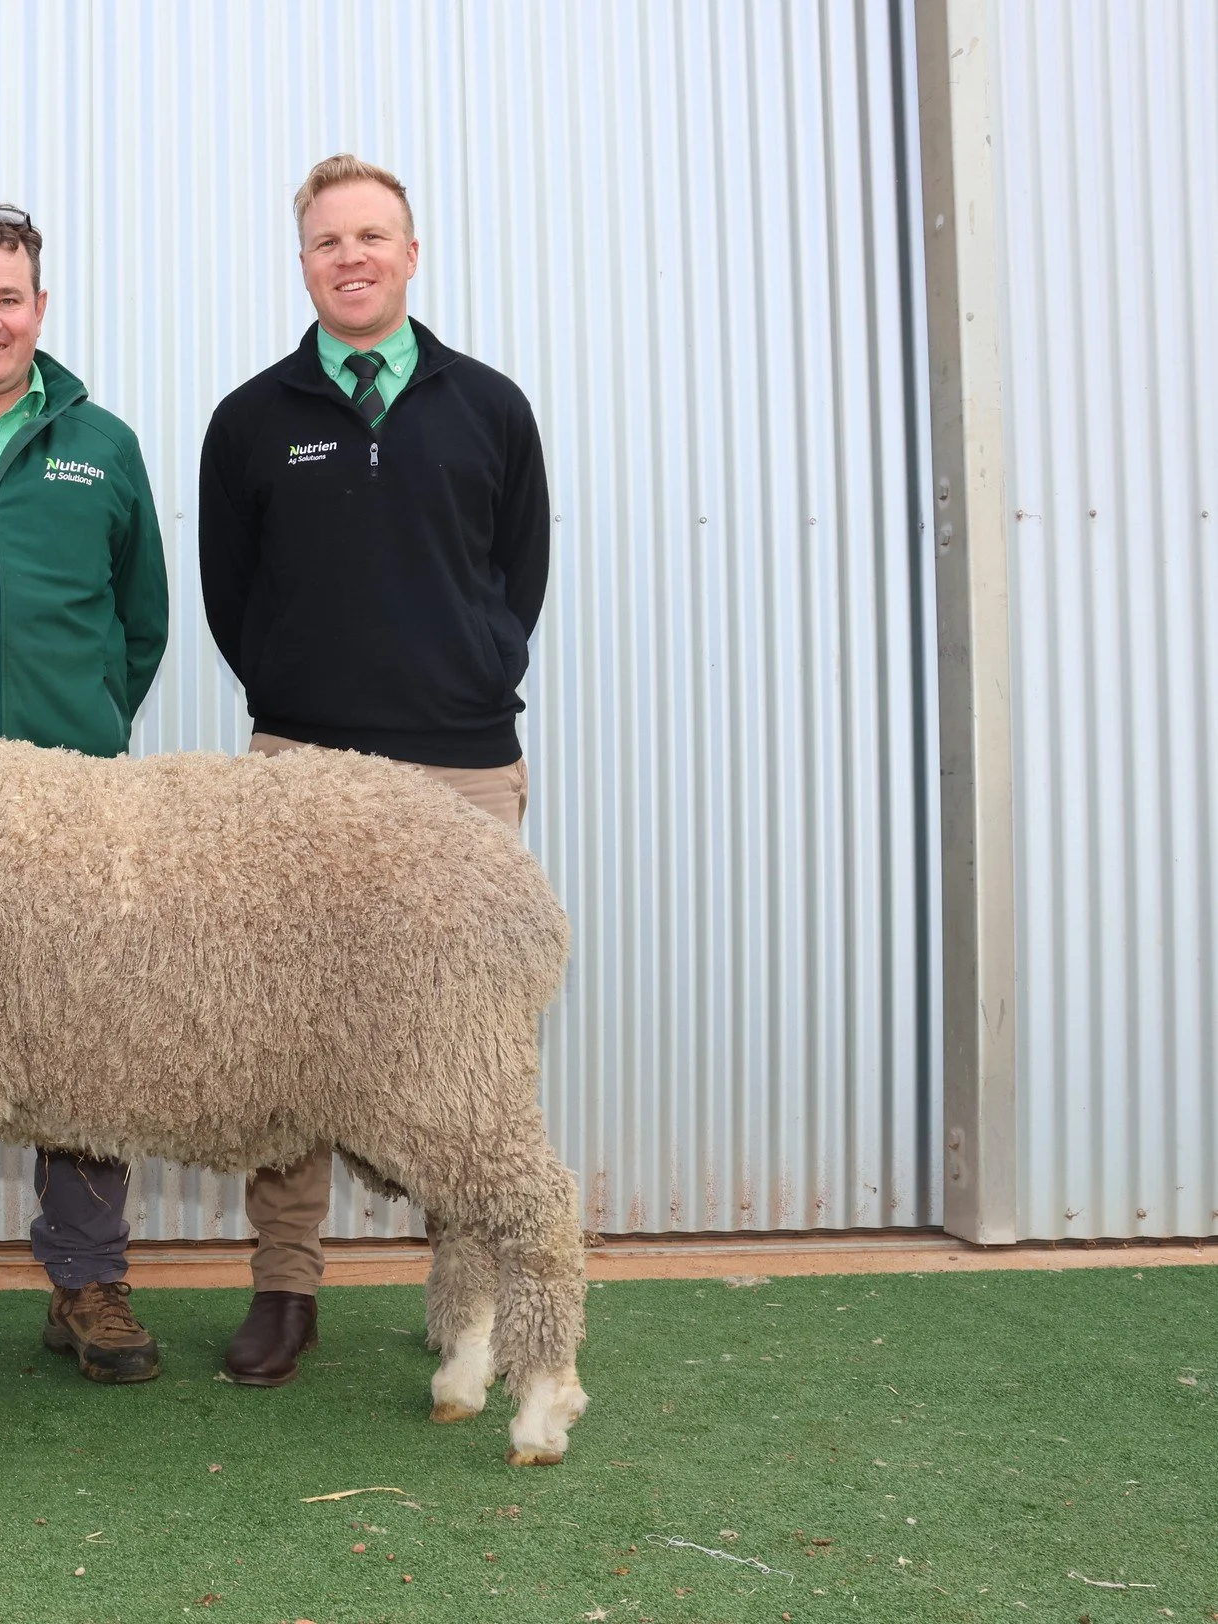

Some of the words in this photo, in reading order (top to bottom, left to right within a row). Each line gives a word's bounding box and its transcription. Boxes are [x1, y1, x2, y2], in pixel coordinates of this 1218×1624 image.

[290, 441, 337, 457] Nutrien
[297, 454, 326, 463] Solutions
[45, 457, 105, 480] Nutrien
[44, 471, 56, 481] Ag
[57, 472, 93, 486] Solutions
